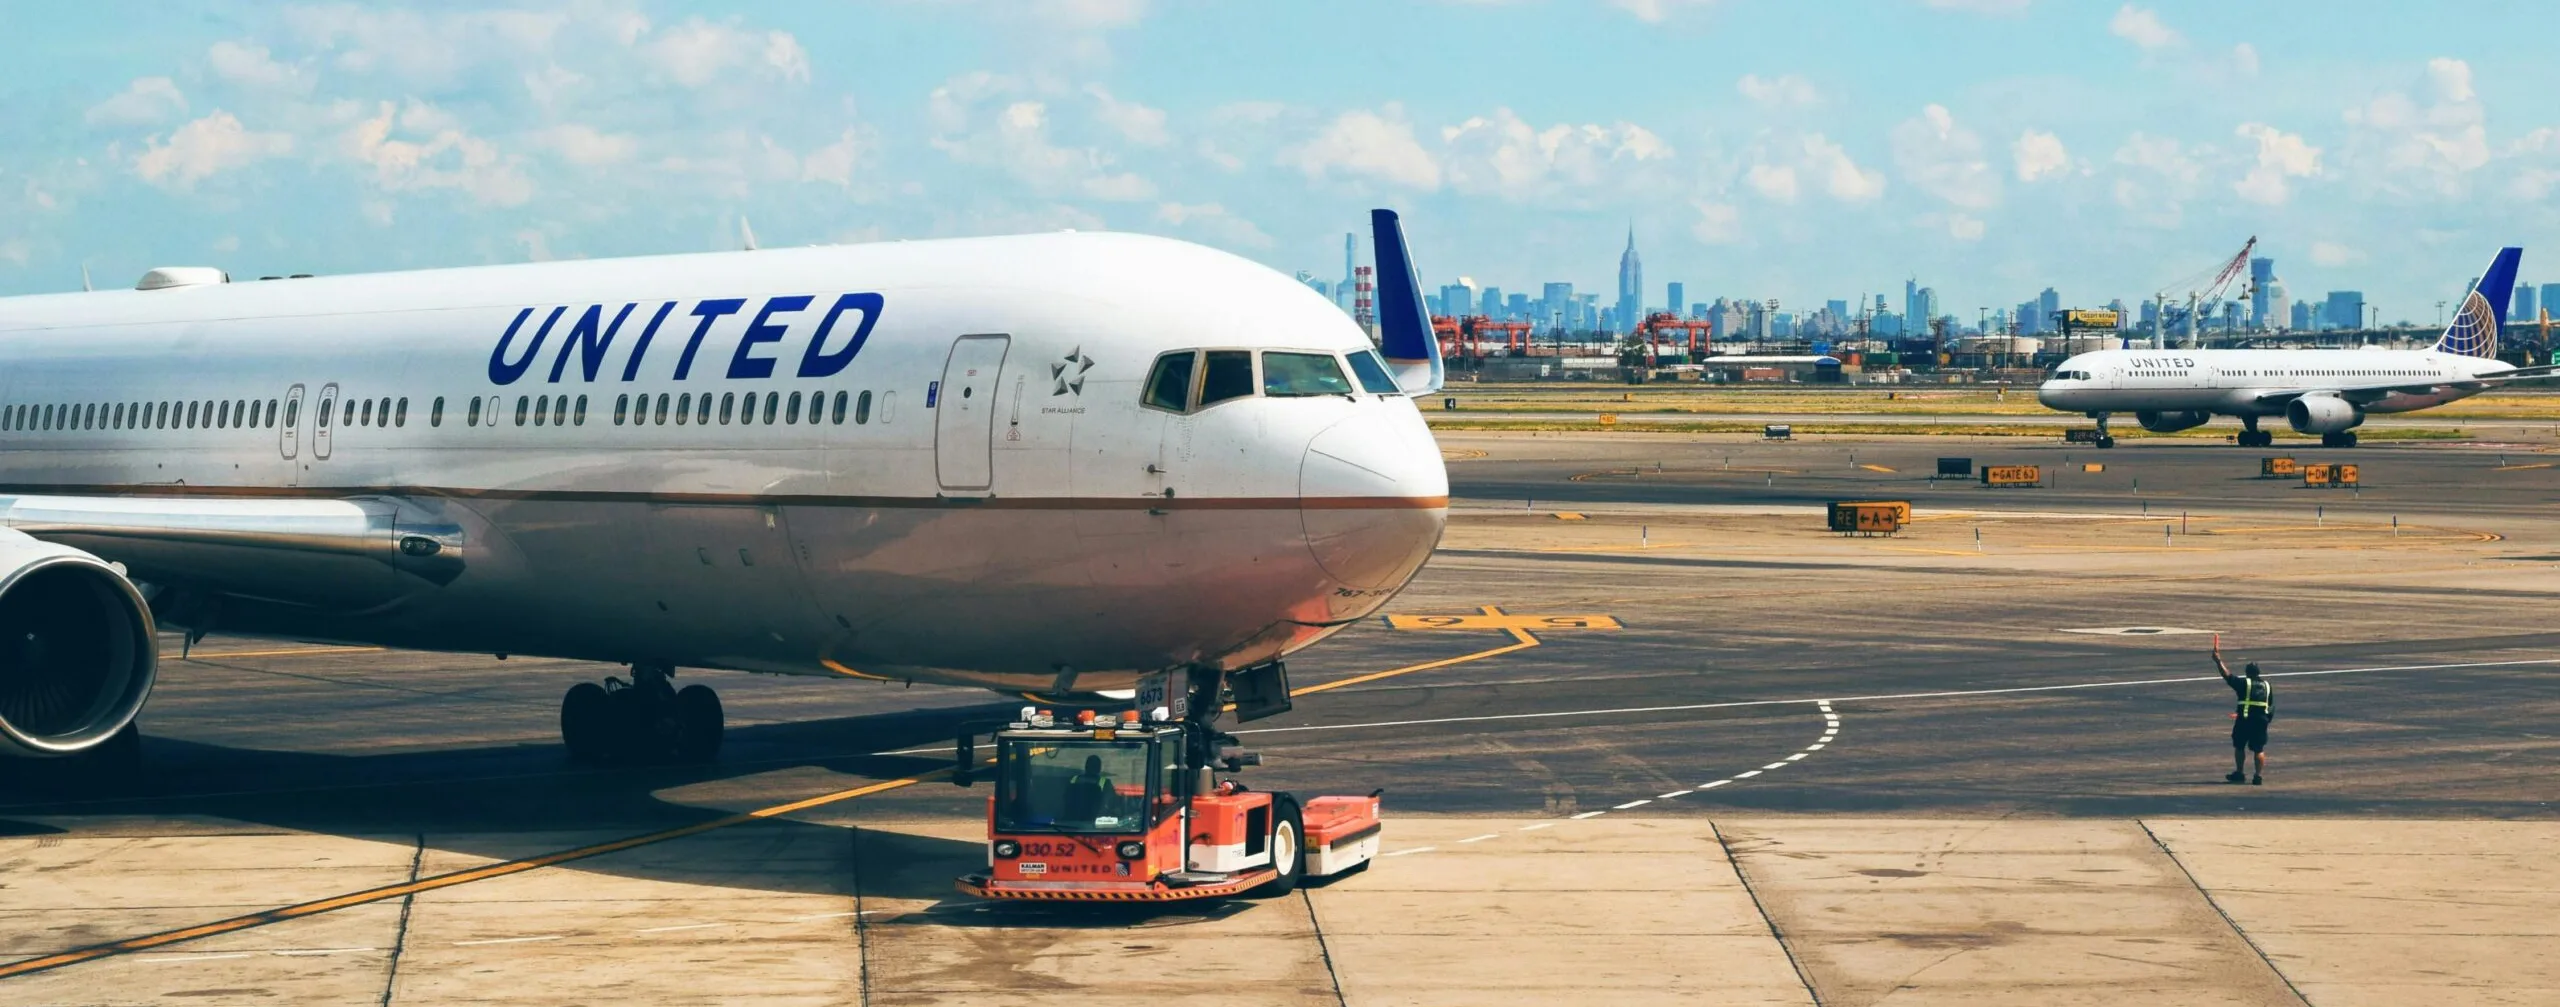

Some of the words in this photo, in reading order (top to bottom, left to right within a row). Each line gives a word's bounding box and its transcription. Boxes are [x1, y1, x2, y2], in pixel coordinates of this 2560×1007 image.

[489, 292, 885, 386] UNITED
[2130, 358, 2195, 368] UNITED
[2000, 469, 2021, 480] GATE
[1837, 510, 1853, 526] RE
[1871, 512, 1880, 527] A
[1051, 864, 1111, 873] UNITED
